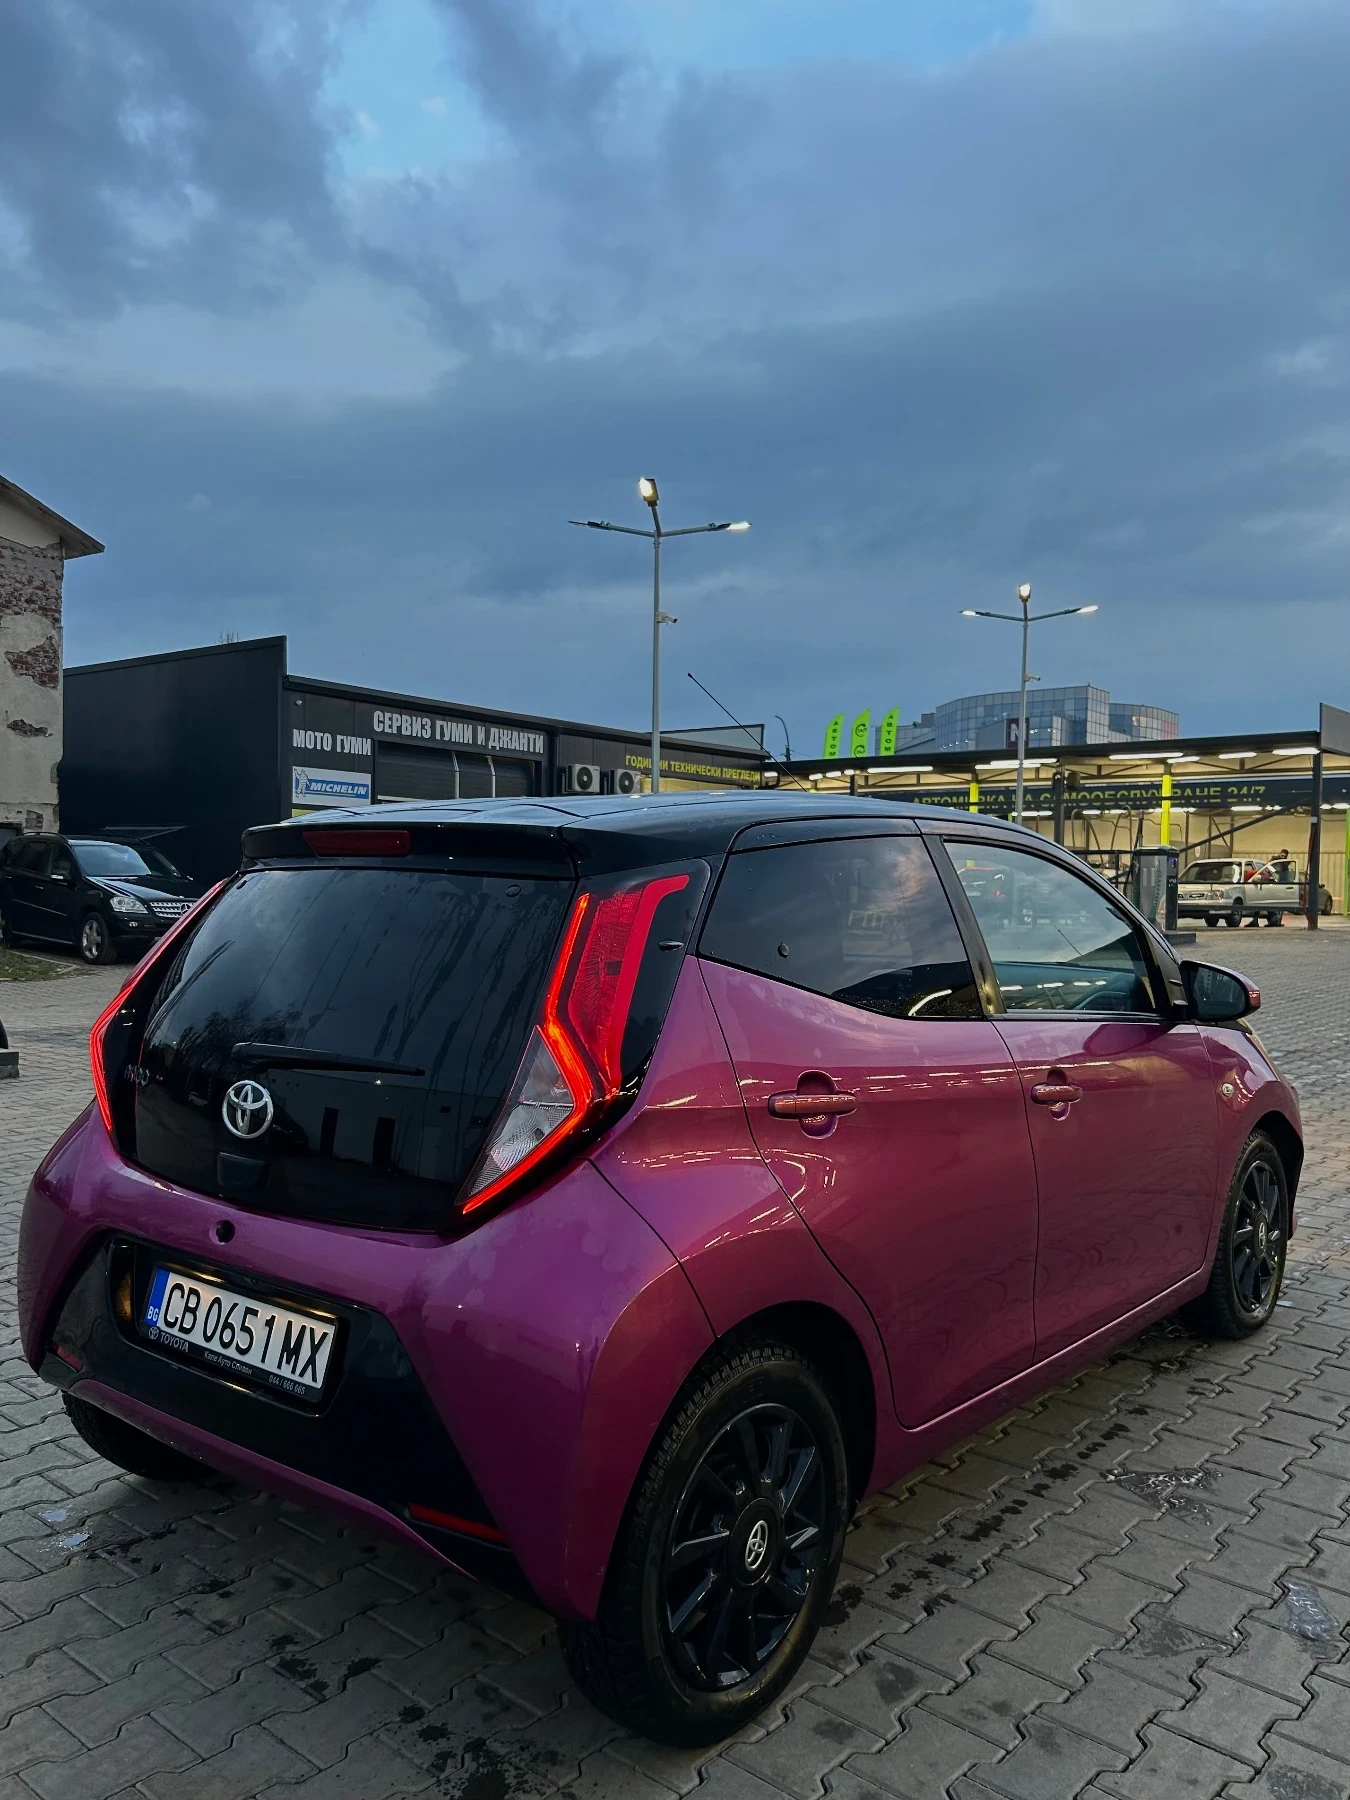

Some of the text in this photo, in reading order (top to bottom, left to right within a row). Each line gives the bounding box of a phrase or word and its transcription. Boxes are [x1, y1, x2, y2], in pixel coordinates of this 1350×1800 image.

[292, 728, 372, 756] МОТО ГУМИ
[373, 710, 544, 754] СЕРВИЗ ГУМИ И ДЖАНТИ
[670, 760, 722, 778] ТЕХНИЧЕСКИ
[722, 768, 761, 783] ПРЕГЛЕДИ
[309, 782, 368, 795] MICHELIN
[147, 1305, 159, 1322] BG
[160, 1331, 189, 1353] TOYOTA
